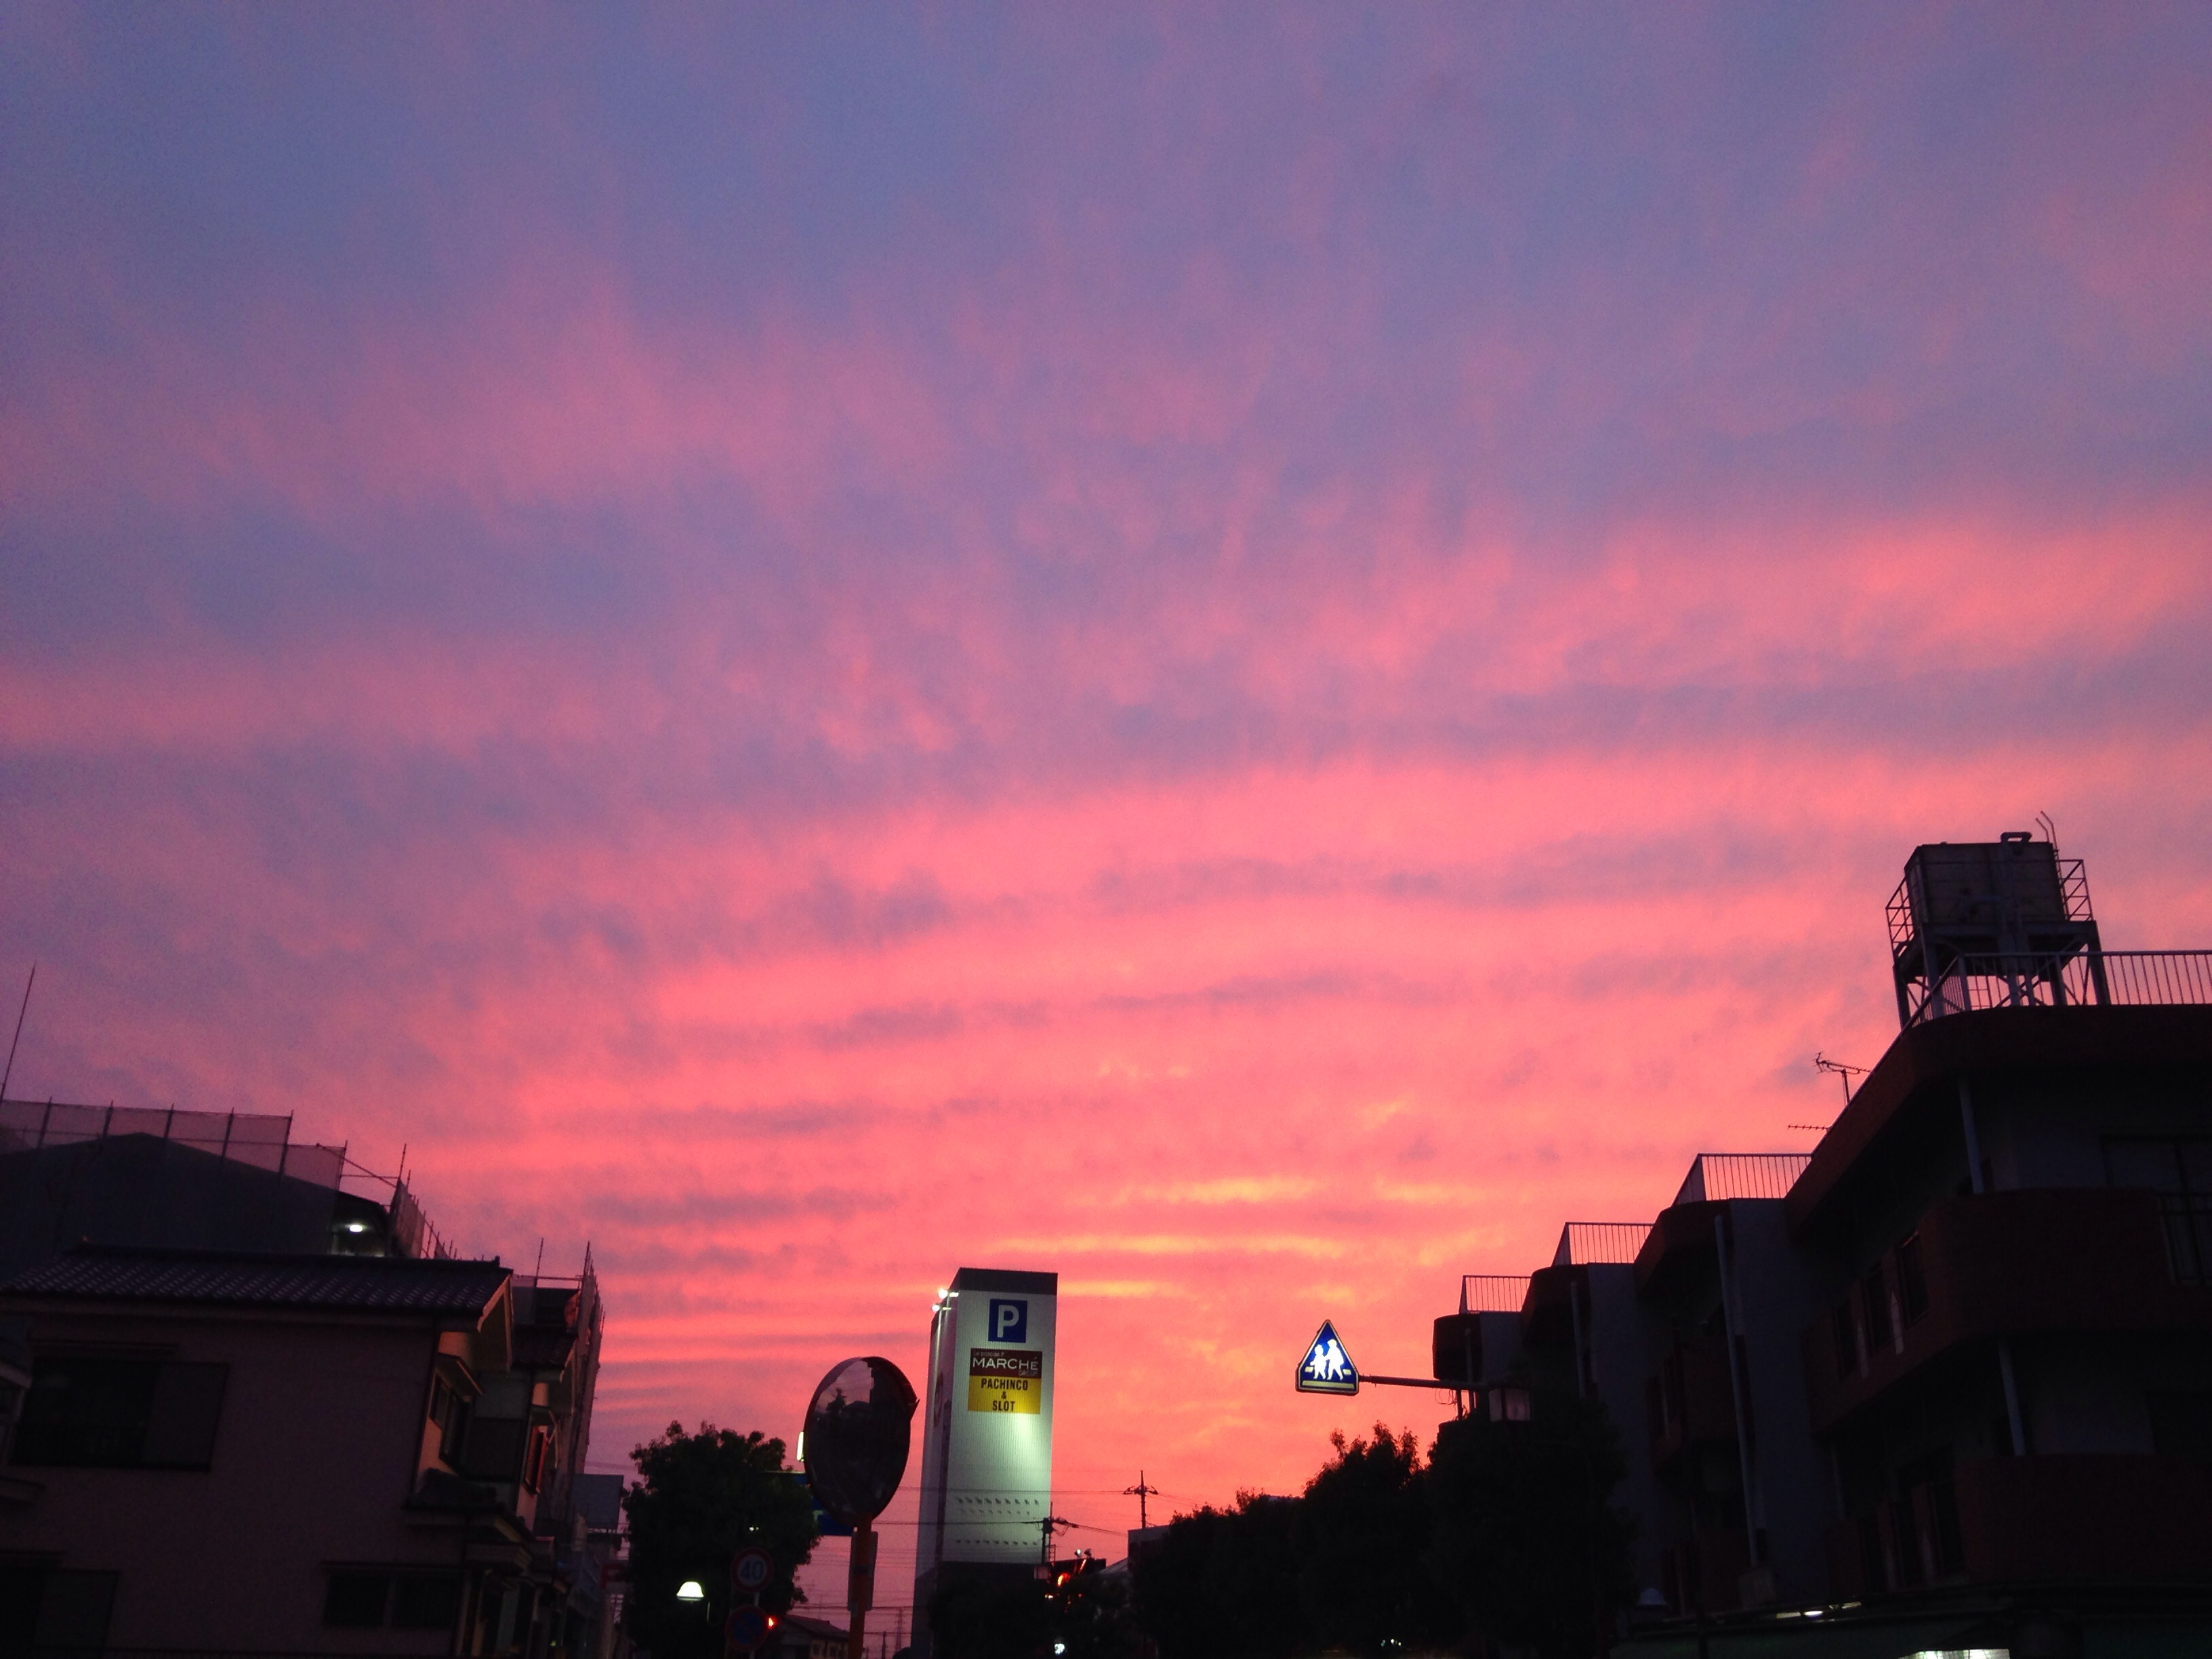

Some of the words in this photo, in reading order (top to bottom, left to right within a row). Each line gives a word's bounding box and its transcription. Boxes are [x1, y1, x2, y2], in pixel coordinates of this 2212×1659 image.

[997, 1304, 1019, 1338] P
[972, 1356, 1039, 1370] MARCHÉ
[981, 1378, 1028, 1391] PACHINCO
[1001, 1391, 1007, 1399] &
[992, 1400, 1016, 1412] SLOT
[741, 1561, 764, 1579] 40
